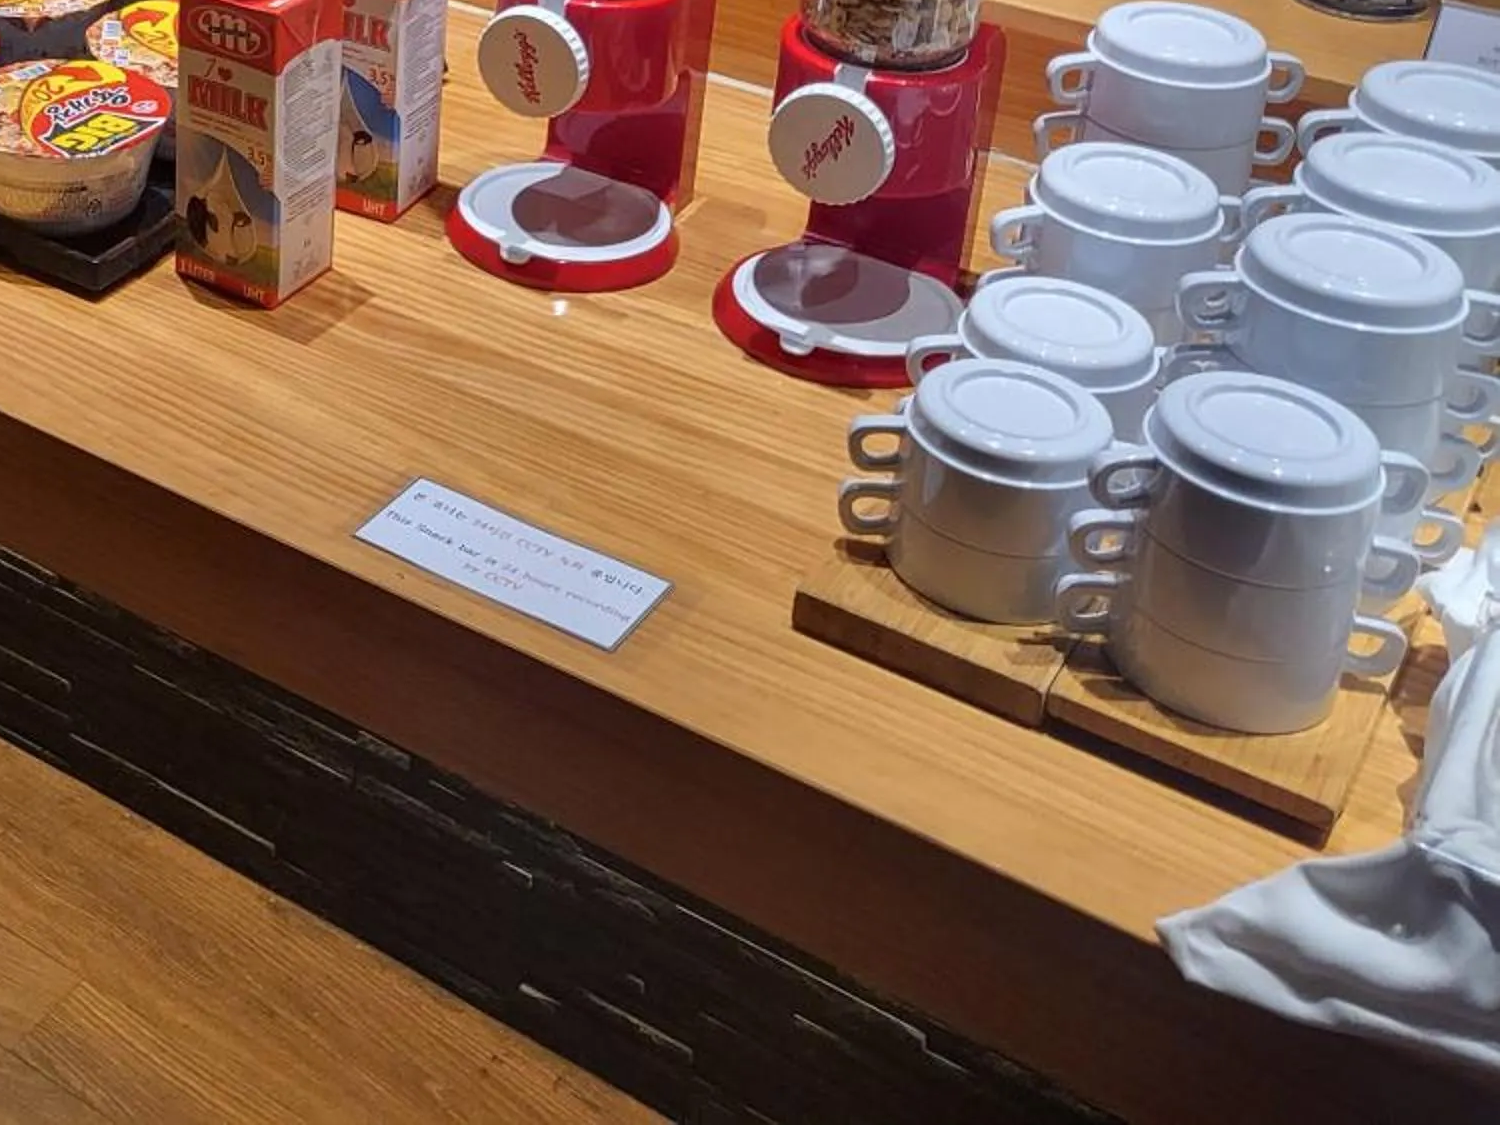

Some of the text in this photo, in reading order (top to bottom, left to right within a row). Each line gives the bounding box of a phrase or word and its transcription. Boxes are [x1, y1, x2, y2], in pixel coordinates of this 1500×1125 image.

[187, 75, 269, 132] MILK
[50, 112, 140, 152] BIG
[802, 115, 855, 180] Kellogg's
[516, 537, 554, 557] CCTV
[484, 571, 524, 591] CCTV
